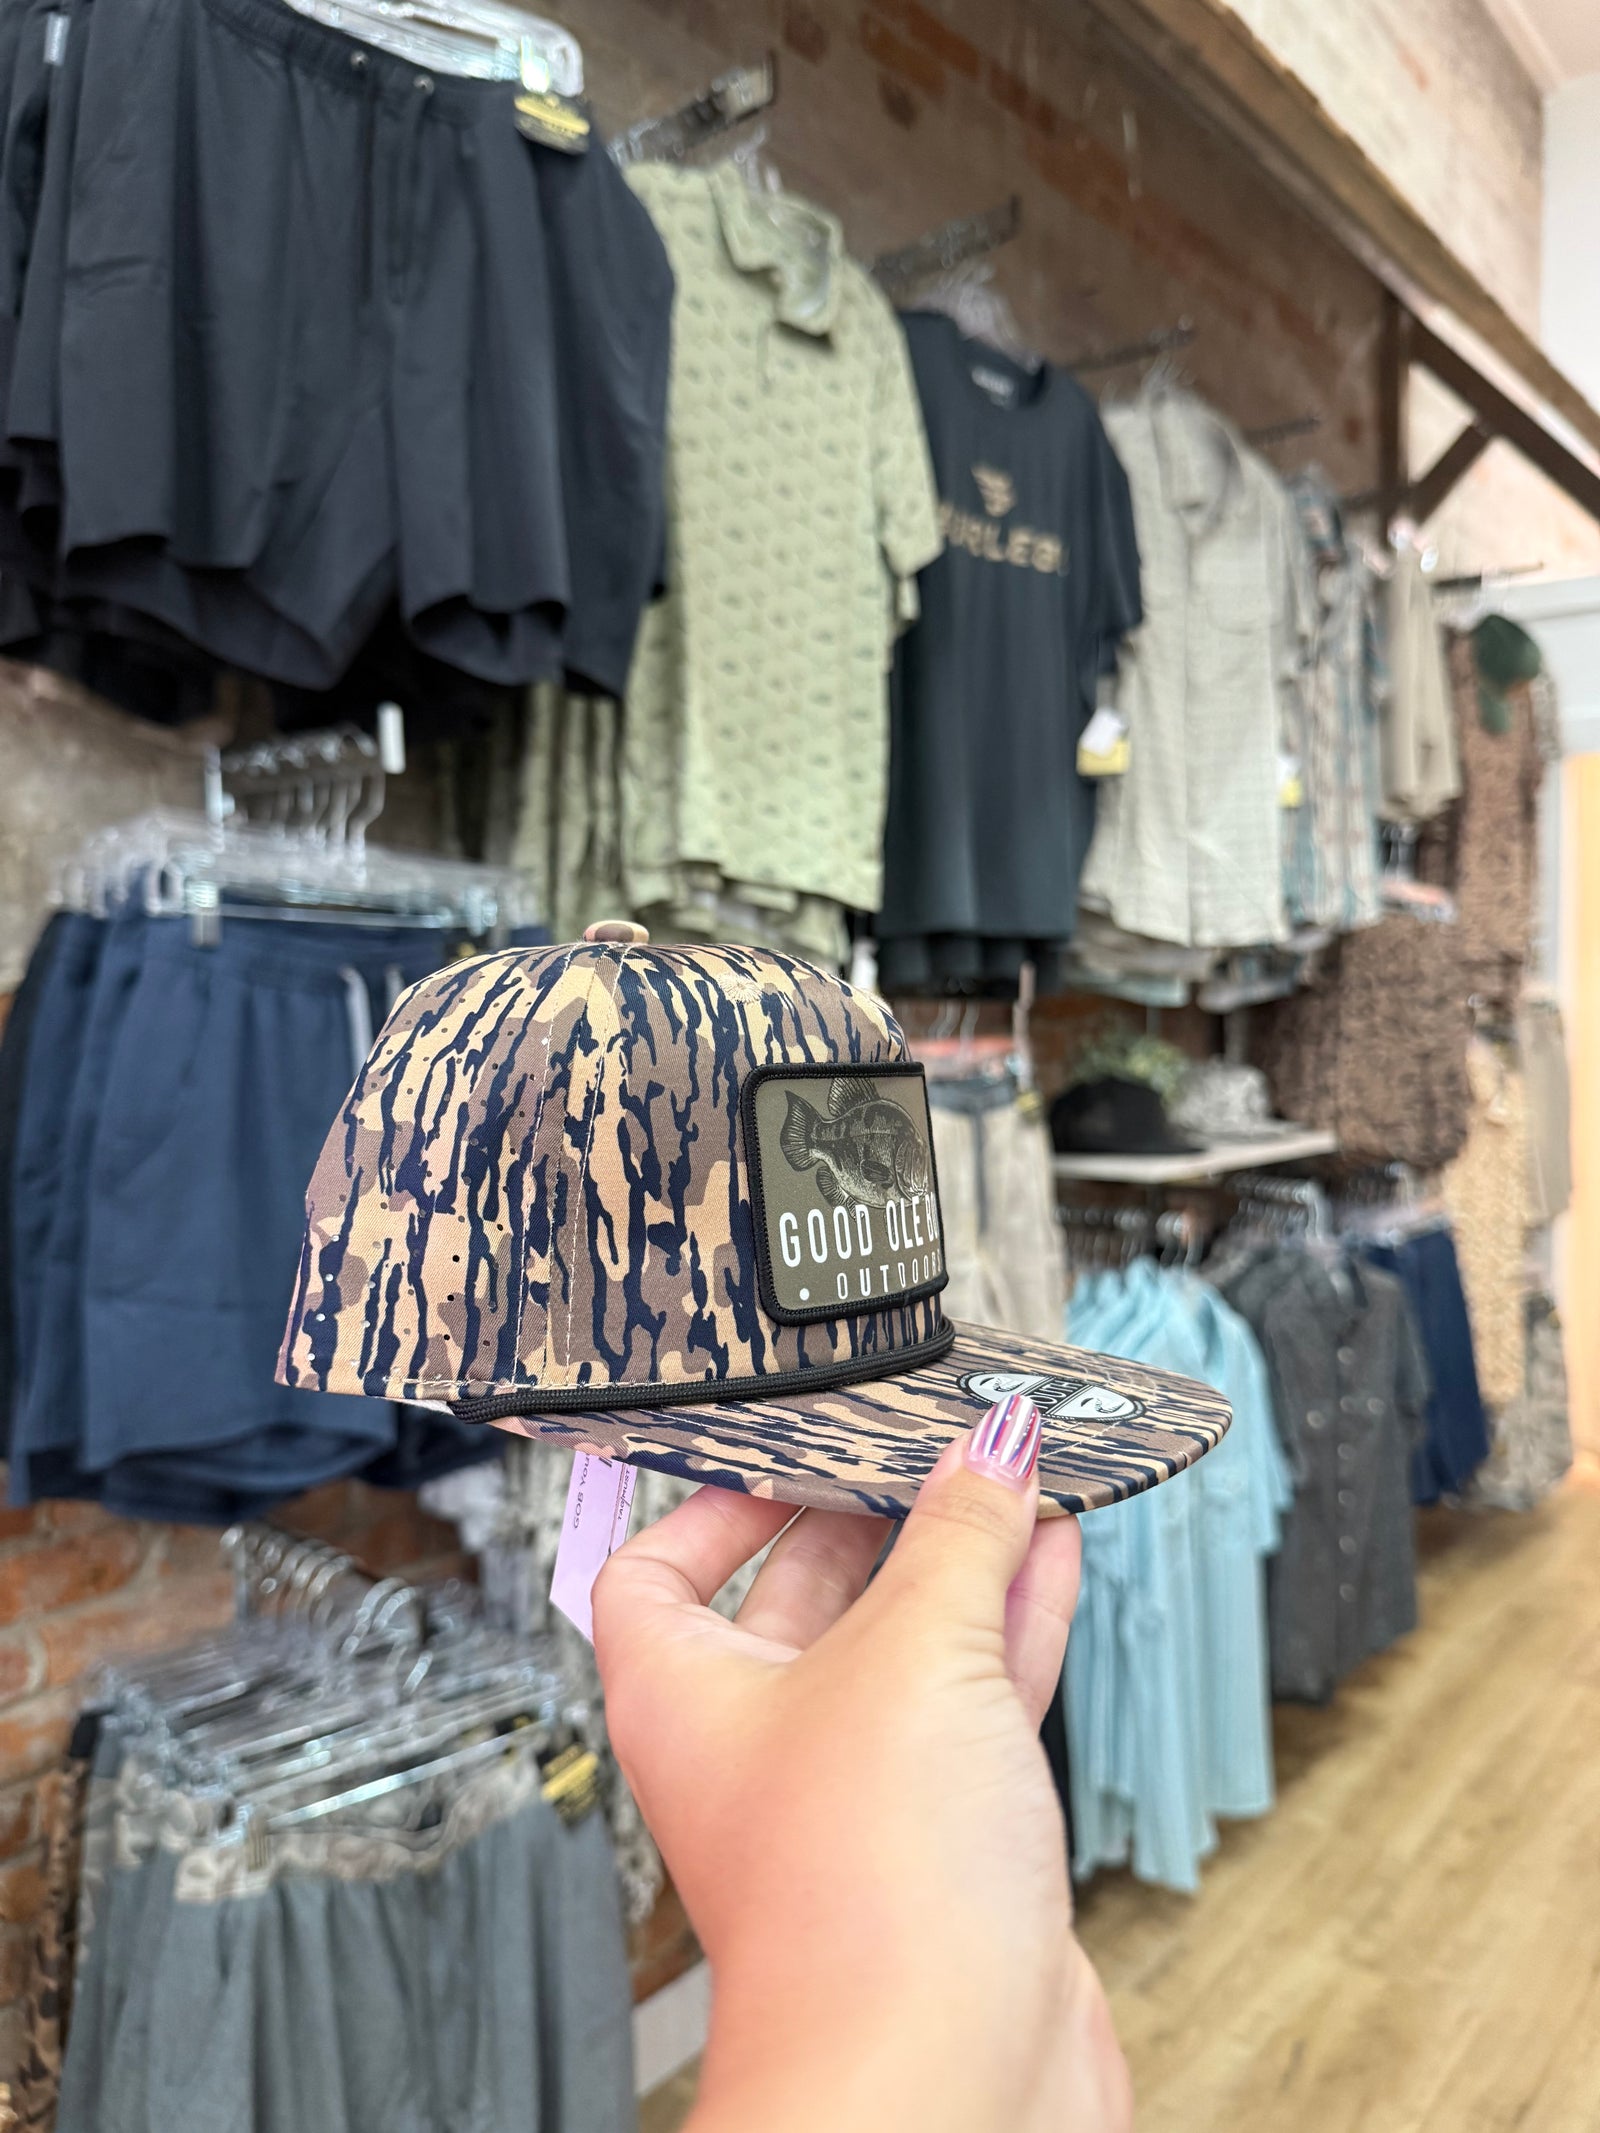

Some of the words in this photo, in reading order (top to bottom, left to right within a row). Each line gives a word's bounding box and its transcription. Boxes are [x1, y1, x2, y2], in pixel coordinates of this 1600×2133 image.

[779, 1203, 873, 1268] GOOD
[885, 1195, 924, 1252] OLE
[573, 1491, 584, 1529] GOB
